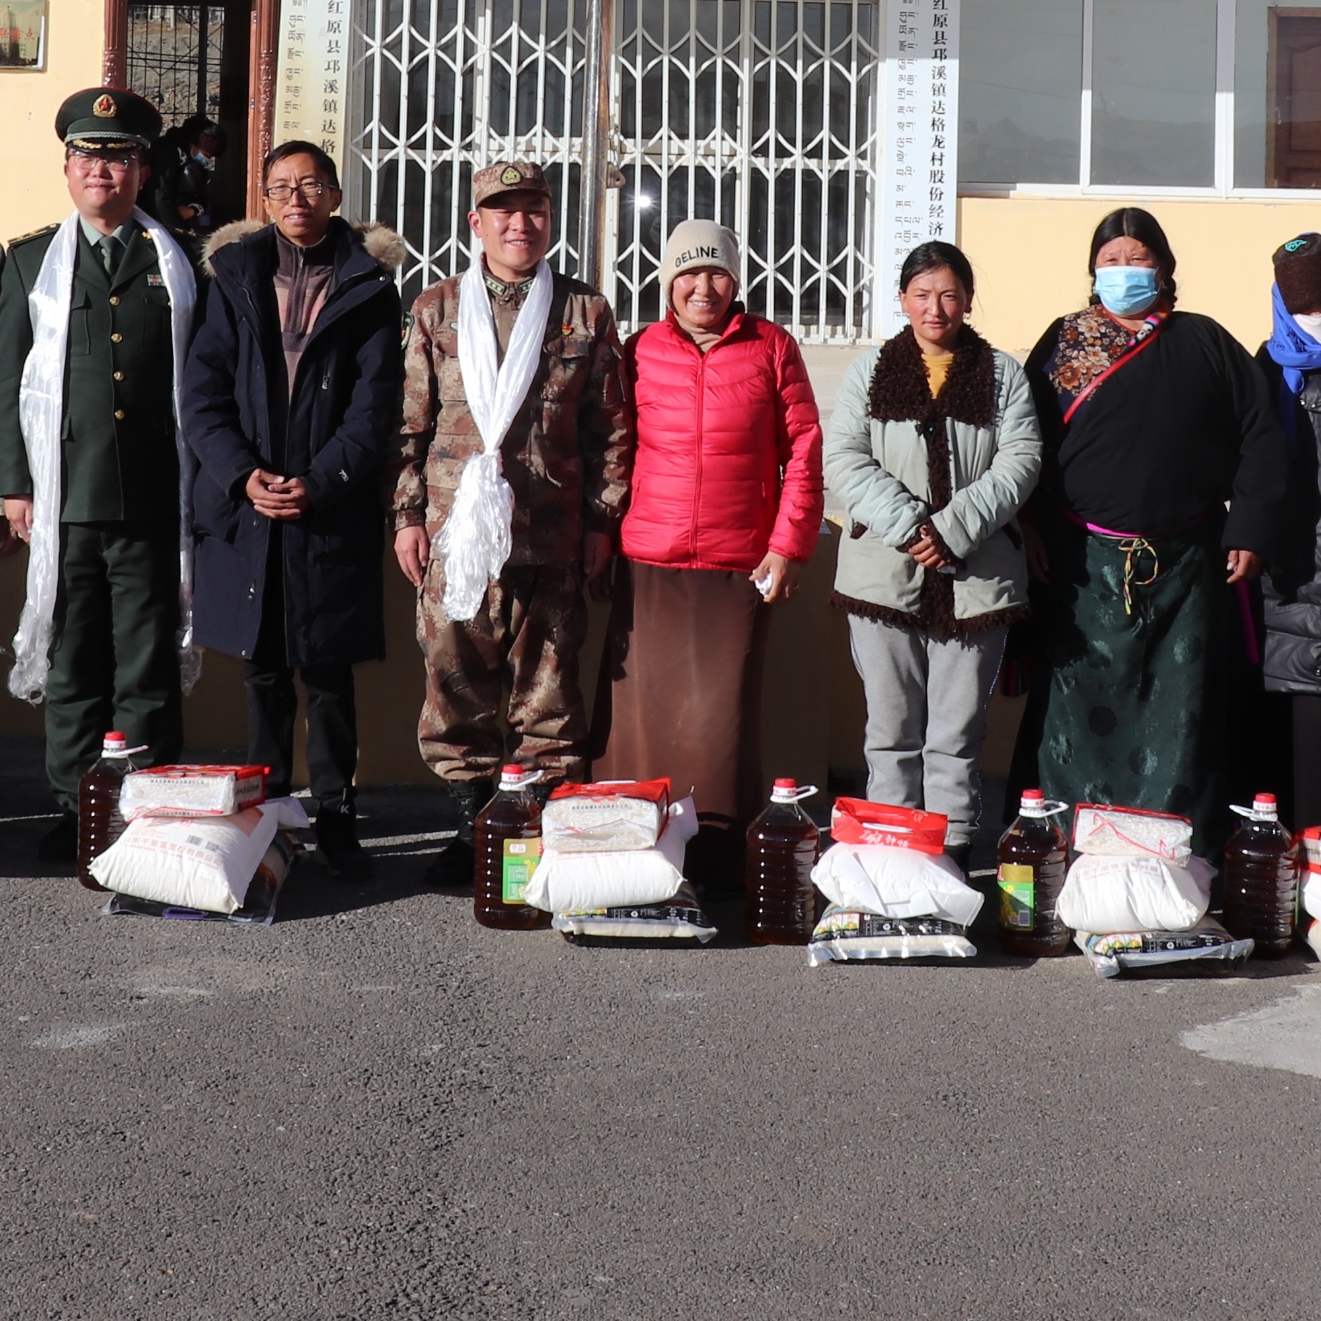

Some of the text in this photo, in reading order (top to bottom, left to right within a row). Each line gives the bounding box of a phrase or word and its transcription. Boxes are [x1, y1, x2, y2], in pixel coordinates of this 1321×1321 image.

[320, 0, 344, 155] 红原县邛溪镇达格
